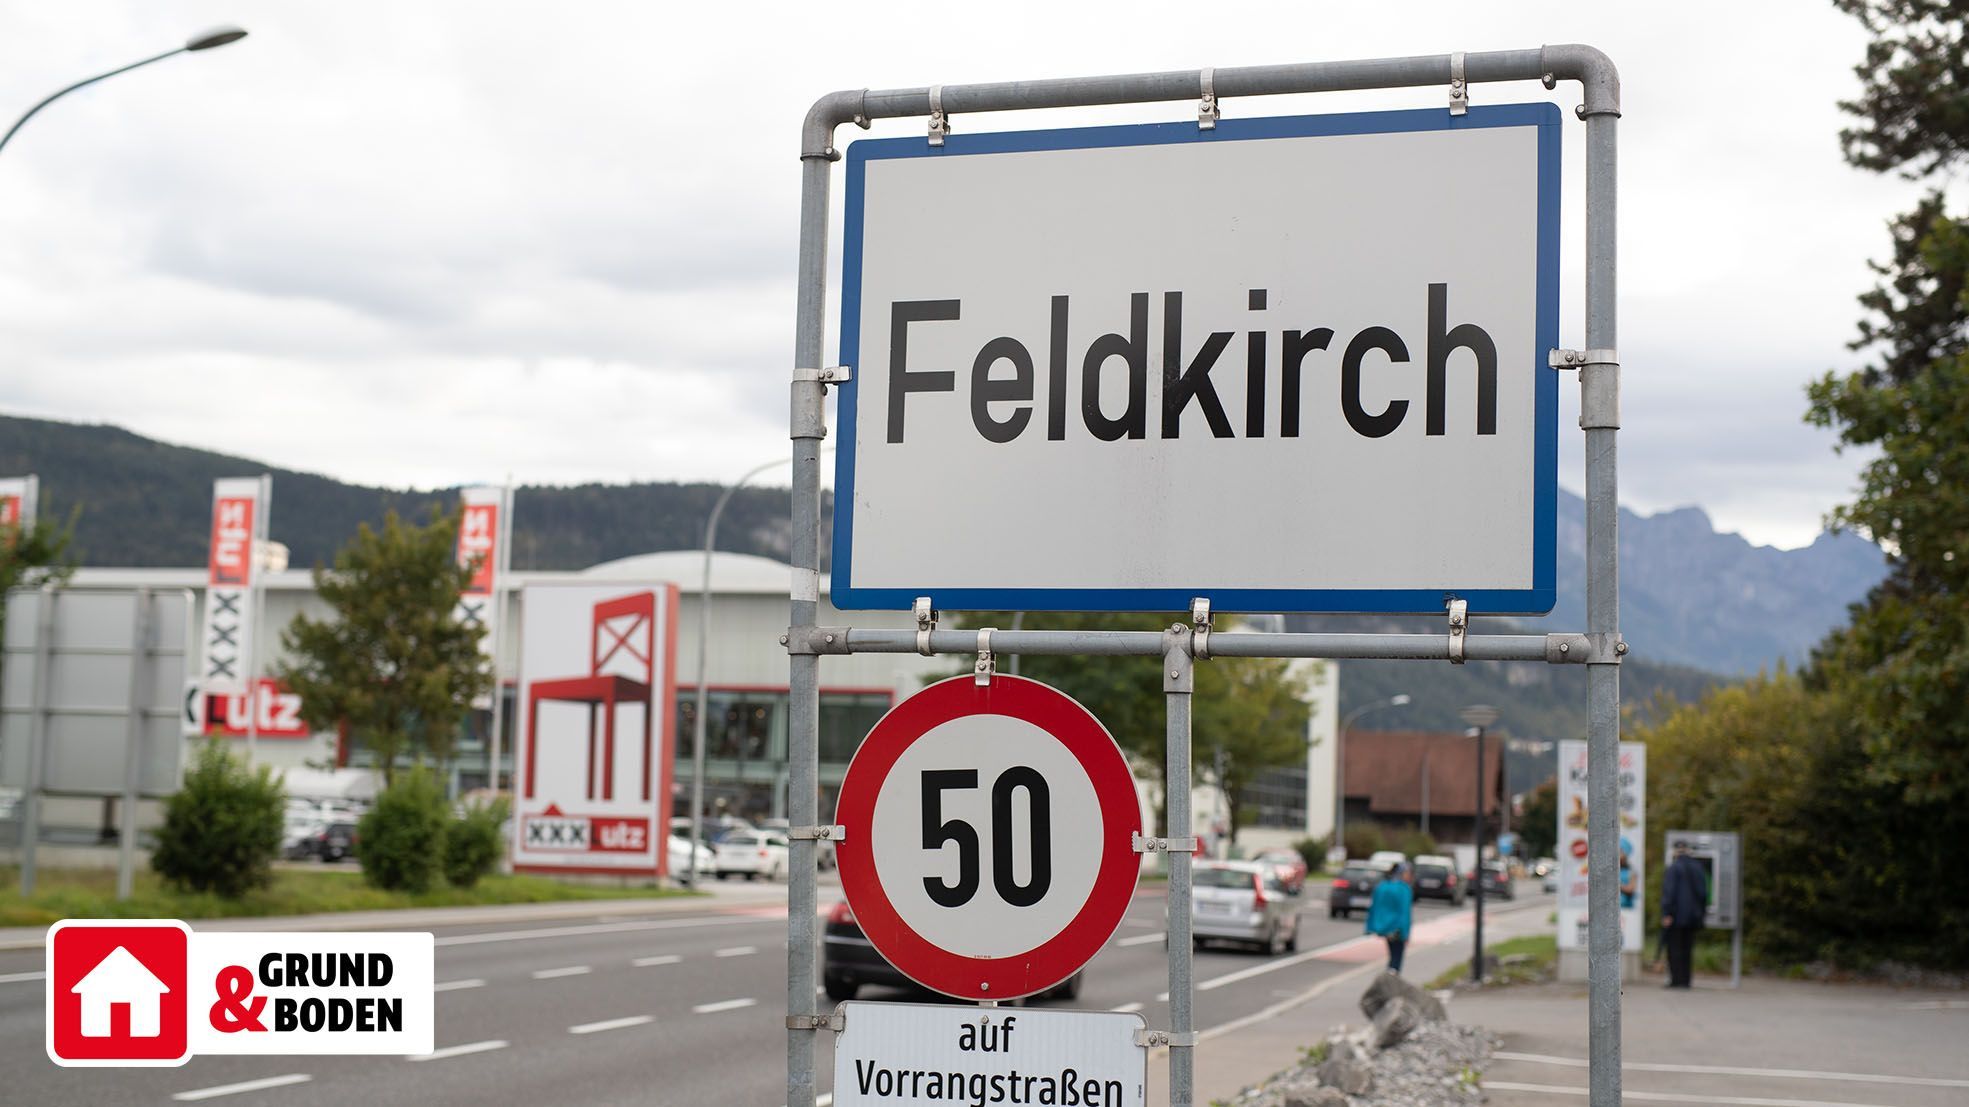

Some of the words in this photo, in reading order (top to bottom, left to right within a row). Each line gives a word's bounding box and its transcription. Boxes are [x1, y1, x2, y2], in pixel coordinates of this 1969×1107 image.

[887, 283, 1497, 443] Feldkirch
[921, 765, 1052, 908] 50
[958, 1016, 1017, 1053] auf
[855, 1059, 1123, 1107] Vorrangstraßen
